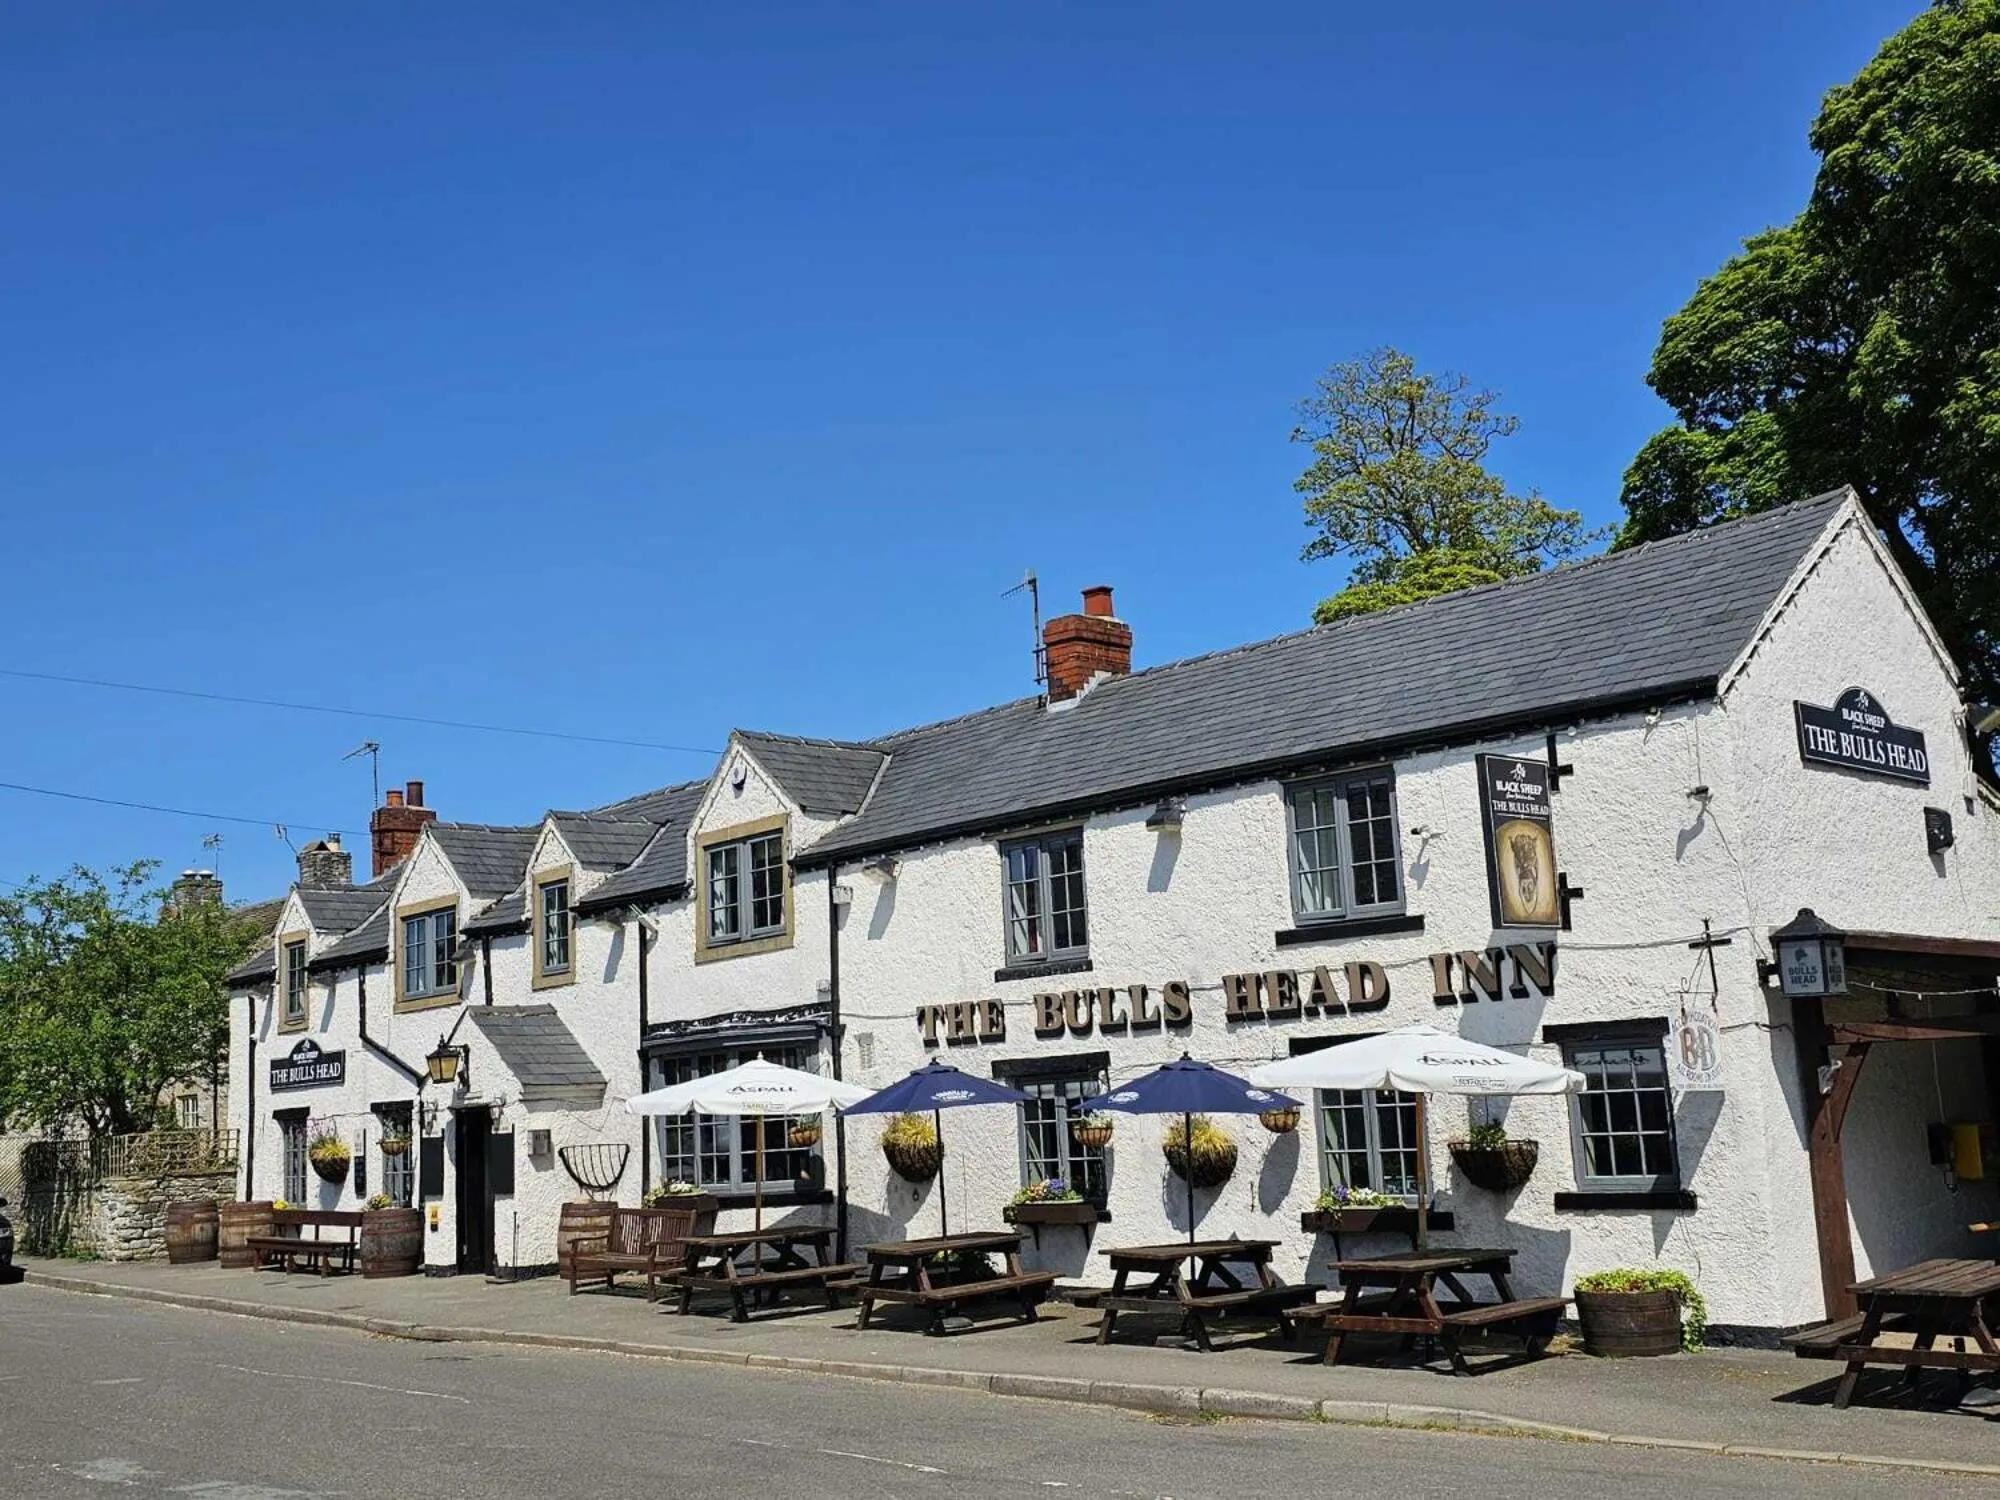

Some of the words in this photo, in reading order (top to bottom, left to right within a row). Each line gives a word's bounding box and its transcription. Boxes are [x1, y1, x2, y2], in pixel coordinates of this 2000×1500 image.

[1841, 708, 1864, 723] BLACK
[1864, 713, 1885, 728] SHEEP
[1804, 724, 1839, 755] THE
[1839, 732, 1885, 764] BULLS
[1886, 742, 1926, 772] HEAD
[1495, 780, 1520, 793] BLACK
[1520, 783, 1542, 796] SHEEP
[1492, 800, 1508, 812] THE
[1508, 801, 1530, 814] BULLS
[1530, 803, 1549, 815] HEAD
[1788, 965, 1818, 976] BULLS
[1791, 975, 1817, 985] HEAD
[916, 998, 1005, 1047] THE
[1033, 981, 1192, 1039] BULLS
[1222, 961, 1389, 1022] HEAD
[1429, 941, 1554, 1006] INN
[1416, 1055, 1510, 1066] ASPALL
[271, 1069, 289, 1084] THE
[289, 1065, 315, 1082] BULLS
[316, 1062, 341, 1079] HEAD
[727, 1085, 797, 1095] ASPALL
